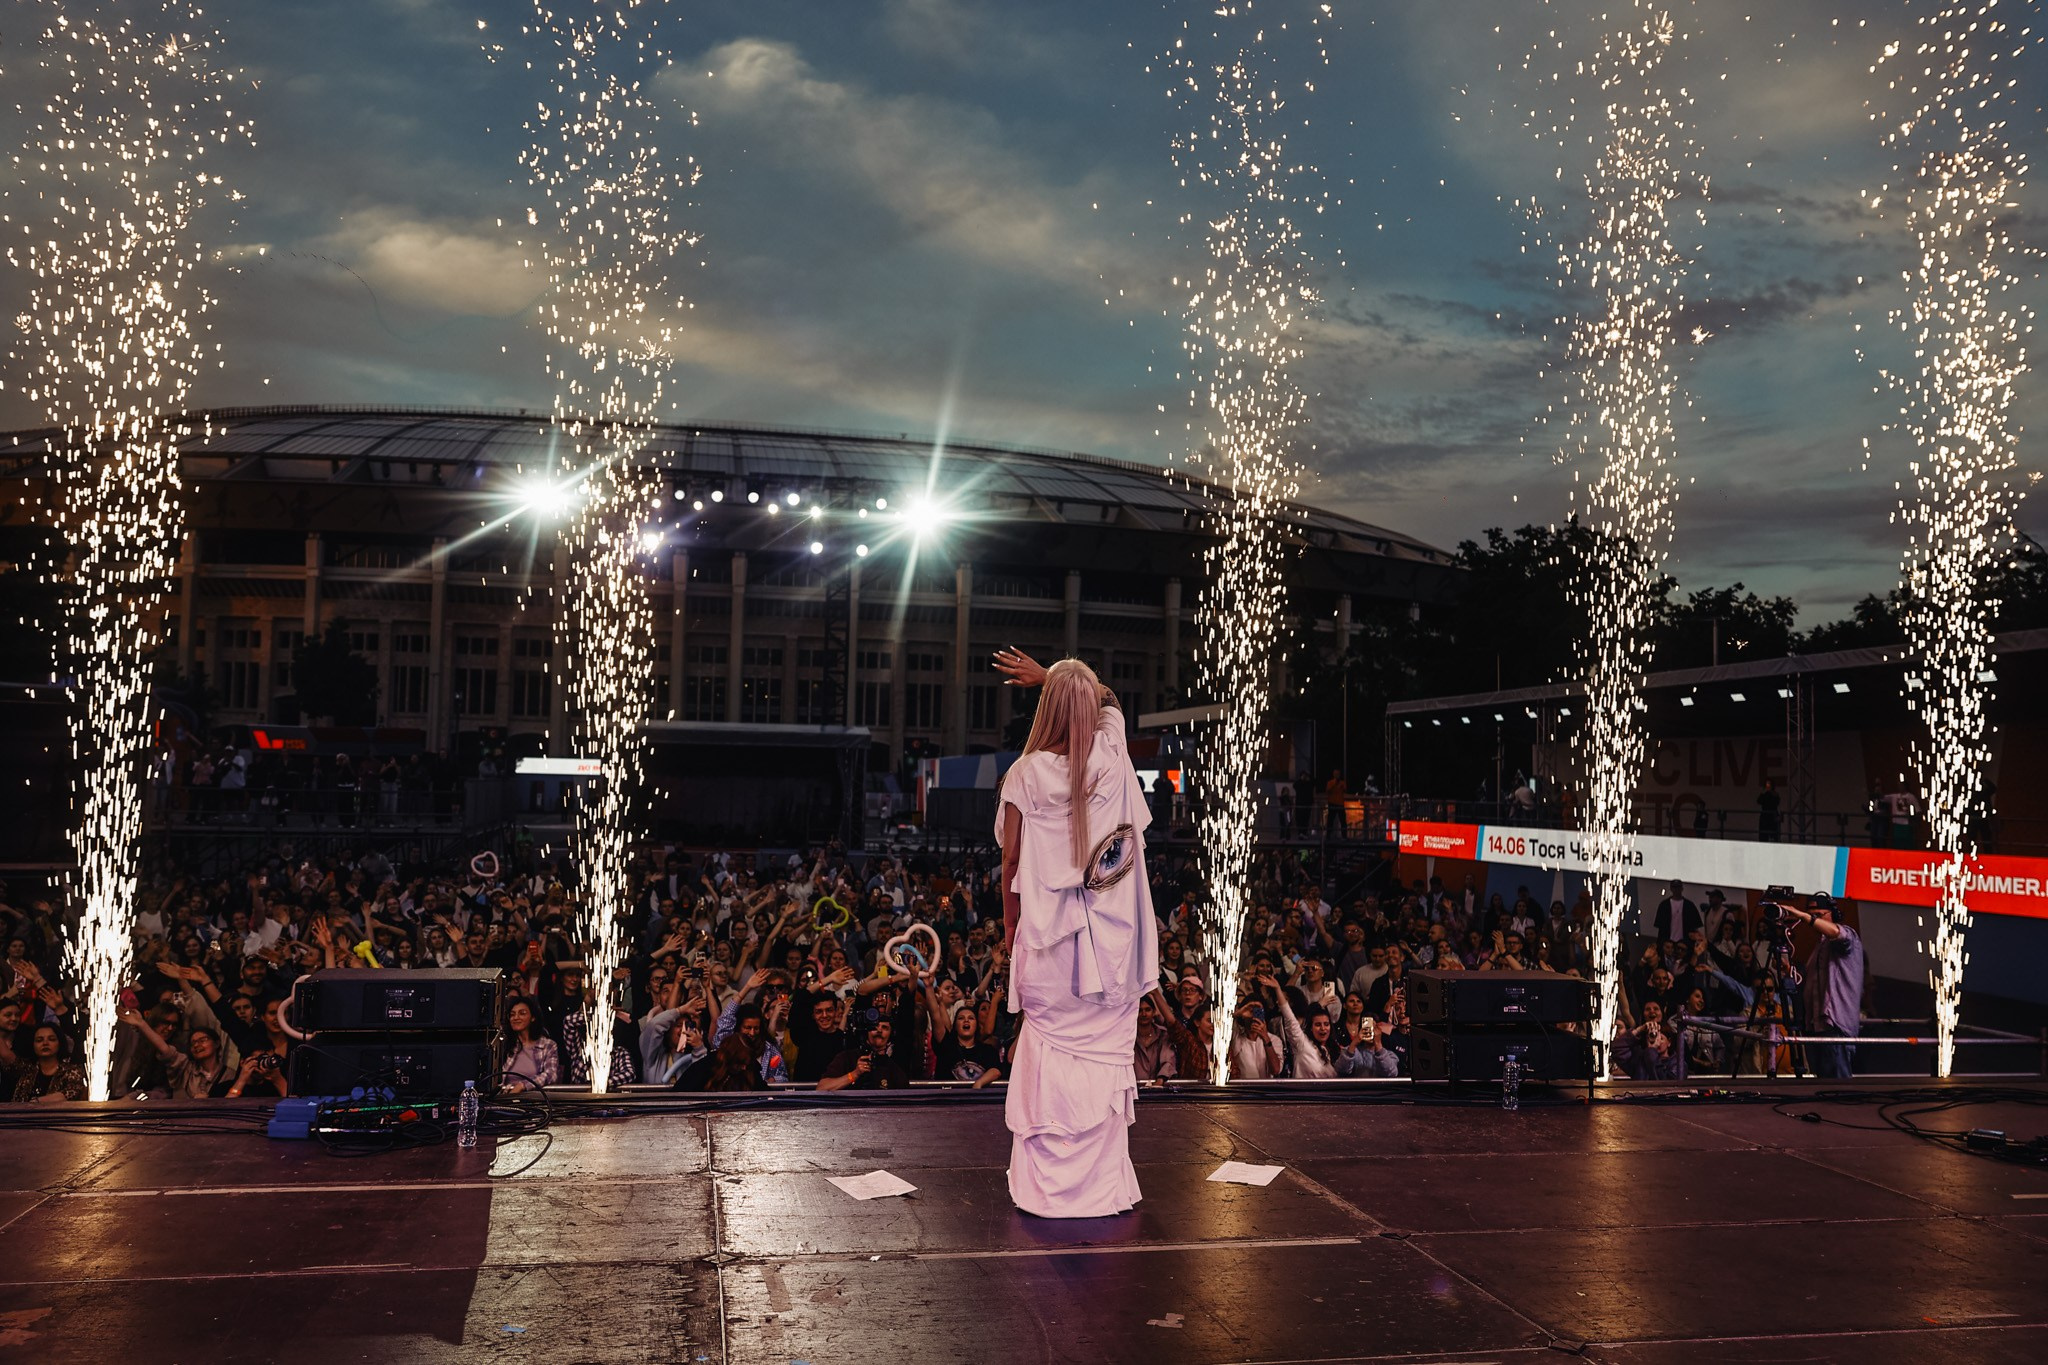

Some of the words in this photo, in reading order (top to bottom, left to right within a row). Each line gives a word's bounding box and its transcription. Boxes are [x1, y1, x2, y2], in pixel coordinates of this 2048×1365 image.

[1689, 739, 1788, 788] LIVE
[1488, 835, 1525, 856] 14.06
[1528, 838, 1566, 859] Тося
